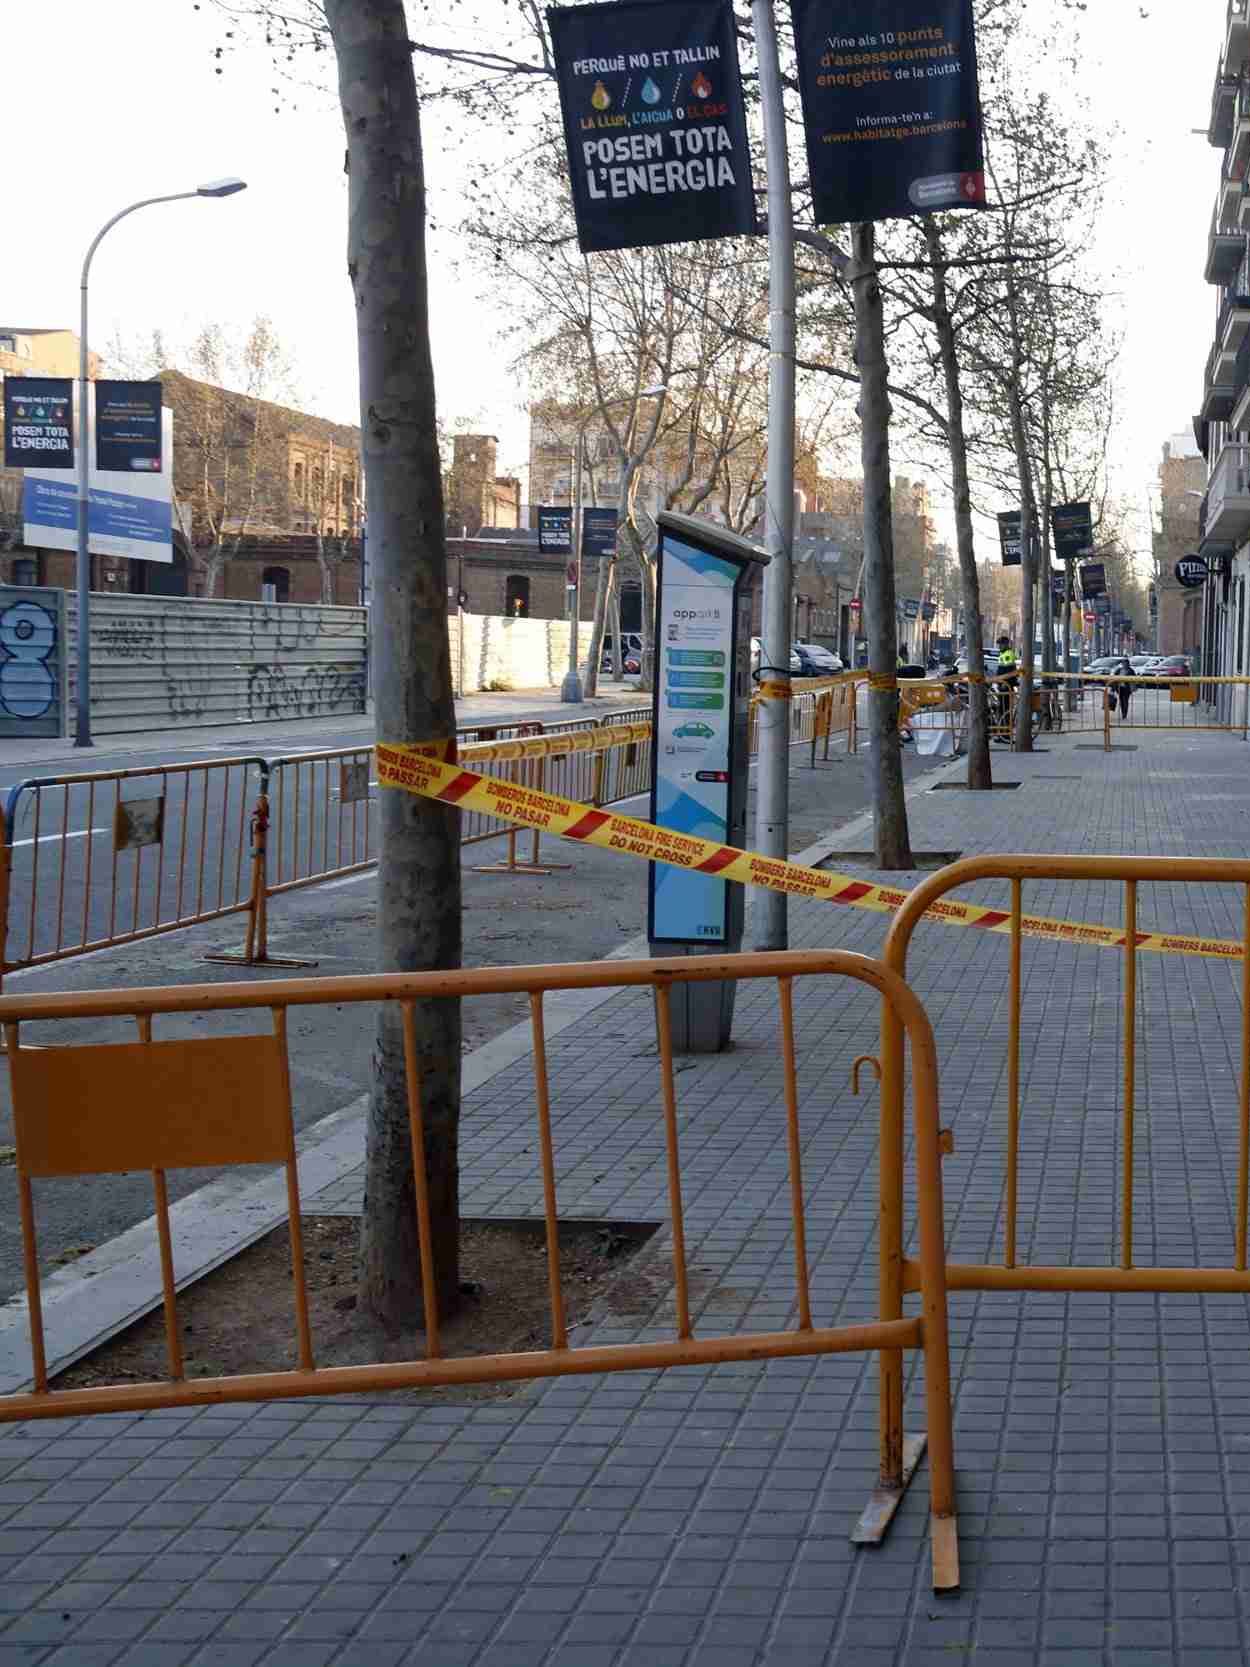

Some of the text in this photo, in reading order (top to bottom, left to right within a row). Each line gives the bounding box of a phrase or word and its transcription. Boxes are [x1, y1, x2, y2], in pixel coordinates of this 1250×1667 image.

[826, 36, 856, 49] Vine
[858, 32, 877, 47] als
[880, 32, 895, 45] 10
[572, 45, 721, 75] PERQUÈ NO ET TALLIN
[894, 69, 910, 80] de
[912, 67, 924, 79] la
[927, 61, 962, 77] ciutat
[582, 125, 733, 166] POSEM TOTA
[586, 156, 737, 200] L'ENERGIA
[44, 426, 70, 437] TOTA
[495, 799, 551, 827] NO PASAR
[609, 834, 693, 866] DO NOT CROSS
[752, 873, 769, 885] NO
